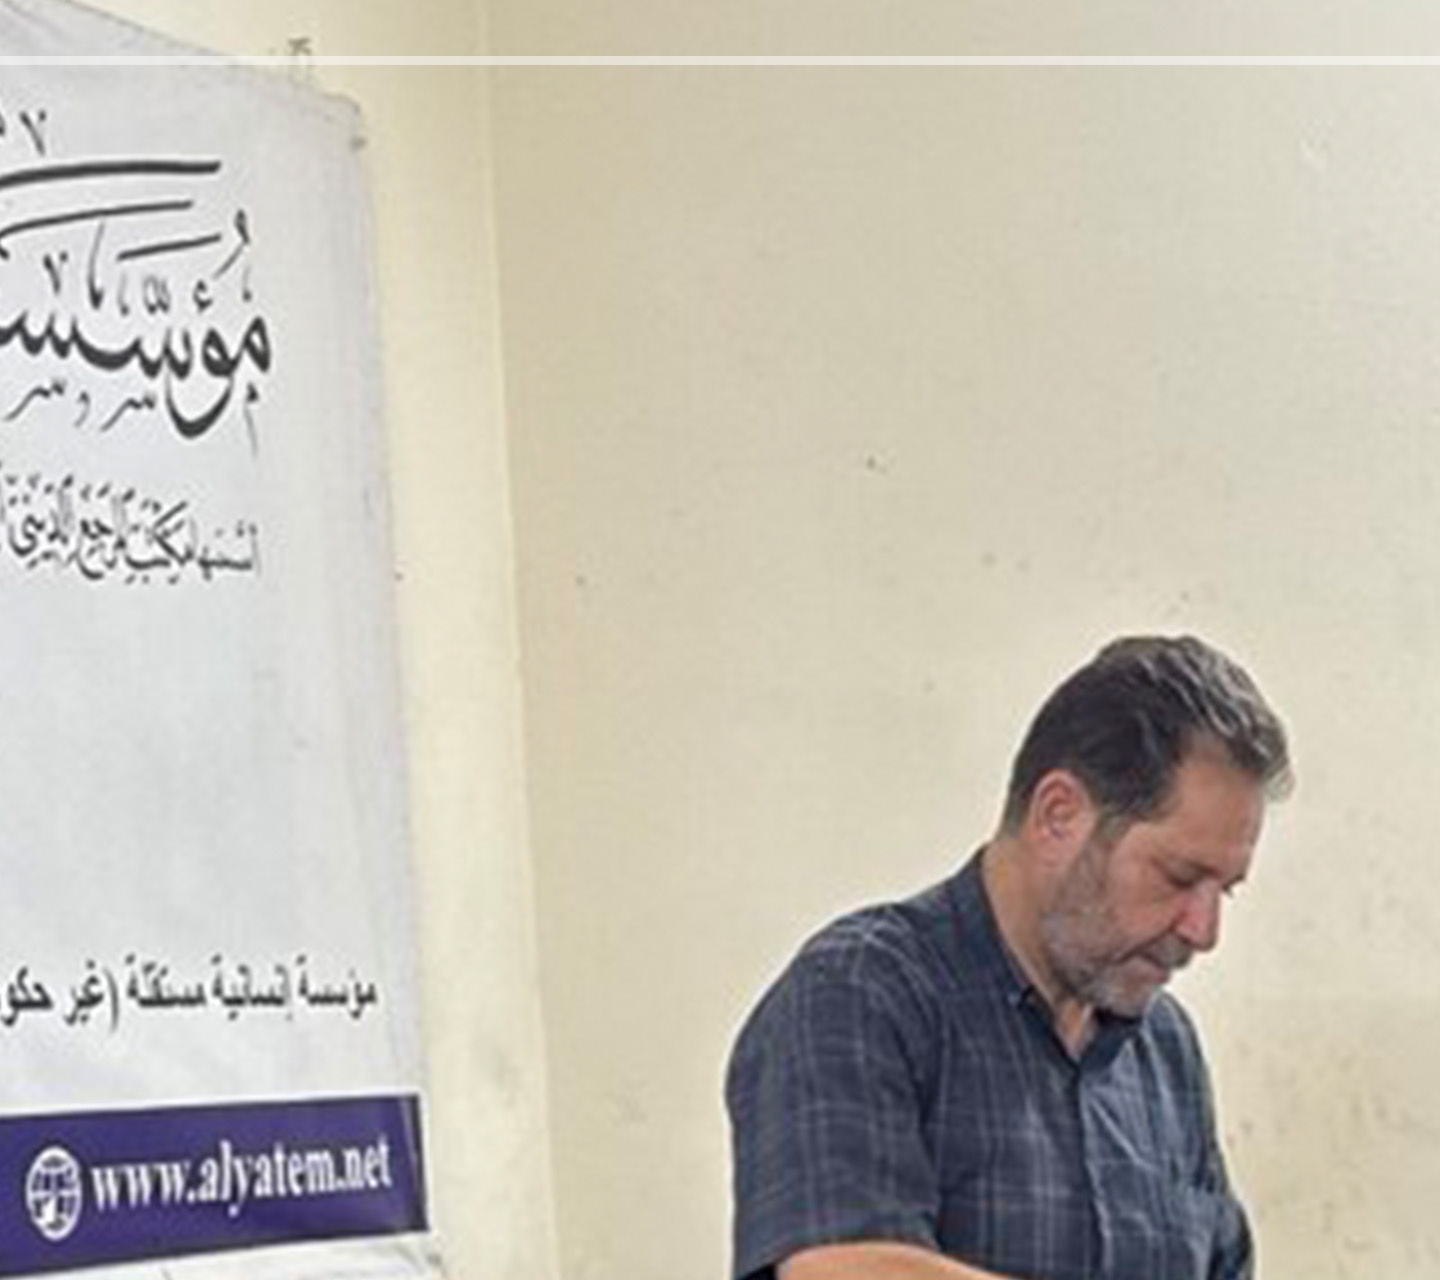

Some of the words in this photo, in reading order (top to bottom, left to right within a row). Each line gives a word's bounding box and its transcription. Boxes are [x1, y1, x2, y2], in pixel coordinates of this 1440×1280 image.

[63, 957, 121, 1034] (غير
[295, 953, 378, 1020] مؤسسة
[89, 1133, 395, 1220] www.alyatem.net
